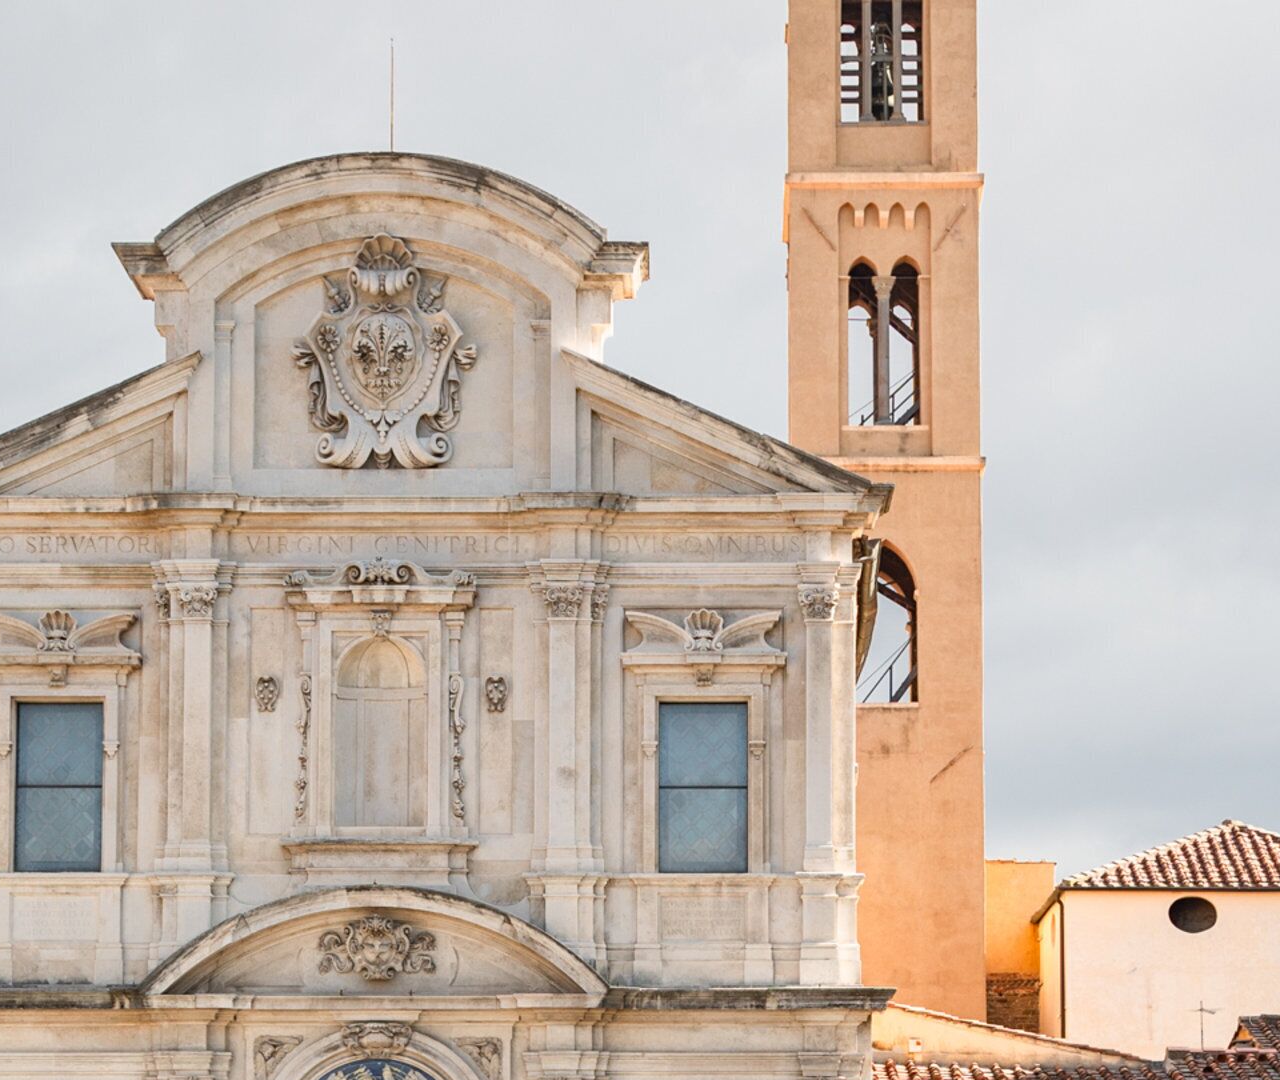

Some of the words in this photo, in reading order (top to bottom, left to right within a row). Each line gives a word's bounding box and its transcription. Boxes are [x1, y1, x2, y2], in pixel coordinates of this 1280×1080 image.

[25, 535, 158, 554] SERVATORI
[246, 535, 354, 554] VIRGINI
[604, 535, 673, 553] DIVIS
